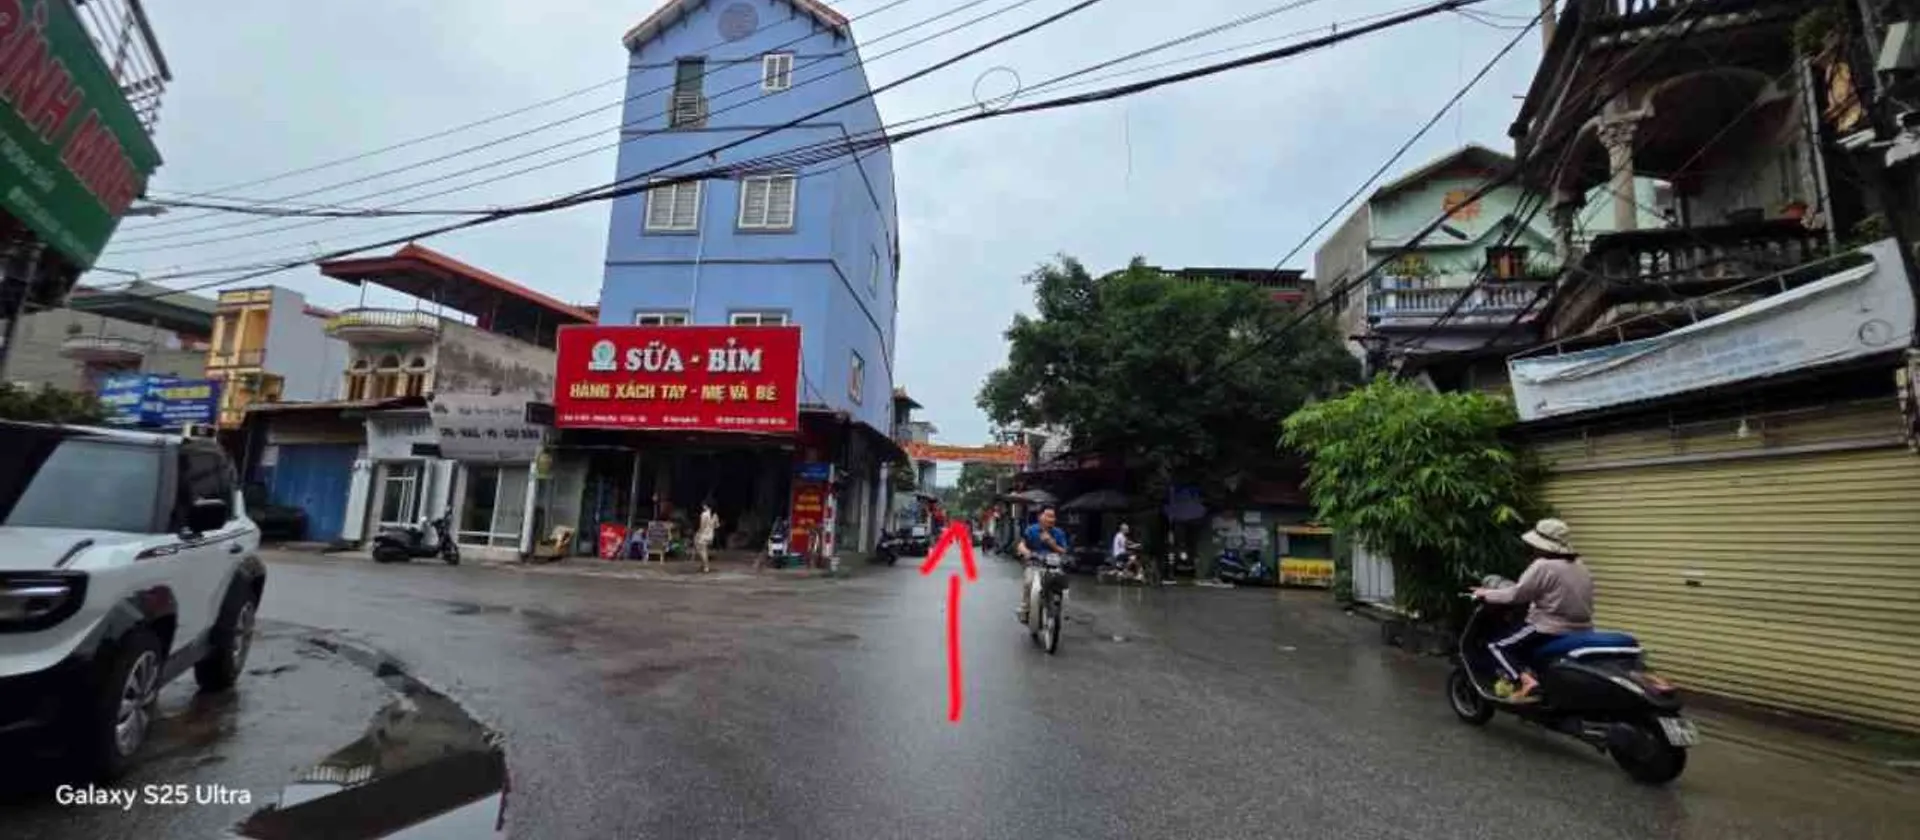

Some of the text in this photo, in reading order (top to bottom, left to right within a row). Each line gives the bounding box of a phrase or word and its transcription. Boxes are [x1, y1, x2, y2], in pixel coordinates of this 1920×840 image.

[624, 341, 684, 372] SỮA
[707, 337, 762, 372] BỈM
[570, 380, 610, 399] HÀNG
[615, 380, 655, 399] XÁCH
[661, 384, 688, 399] TAY
[701, 384, 726, 404] MẸ
[729, 380, 749, 400] VÀ
[755, 380, 778, 401] BÉ
